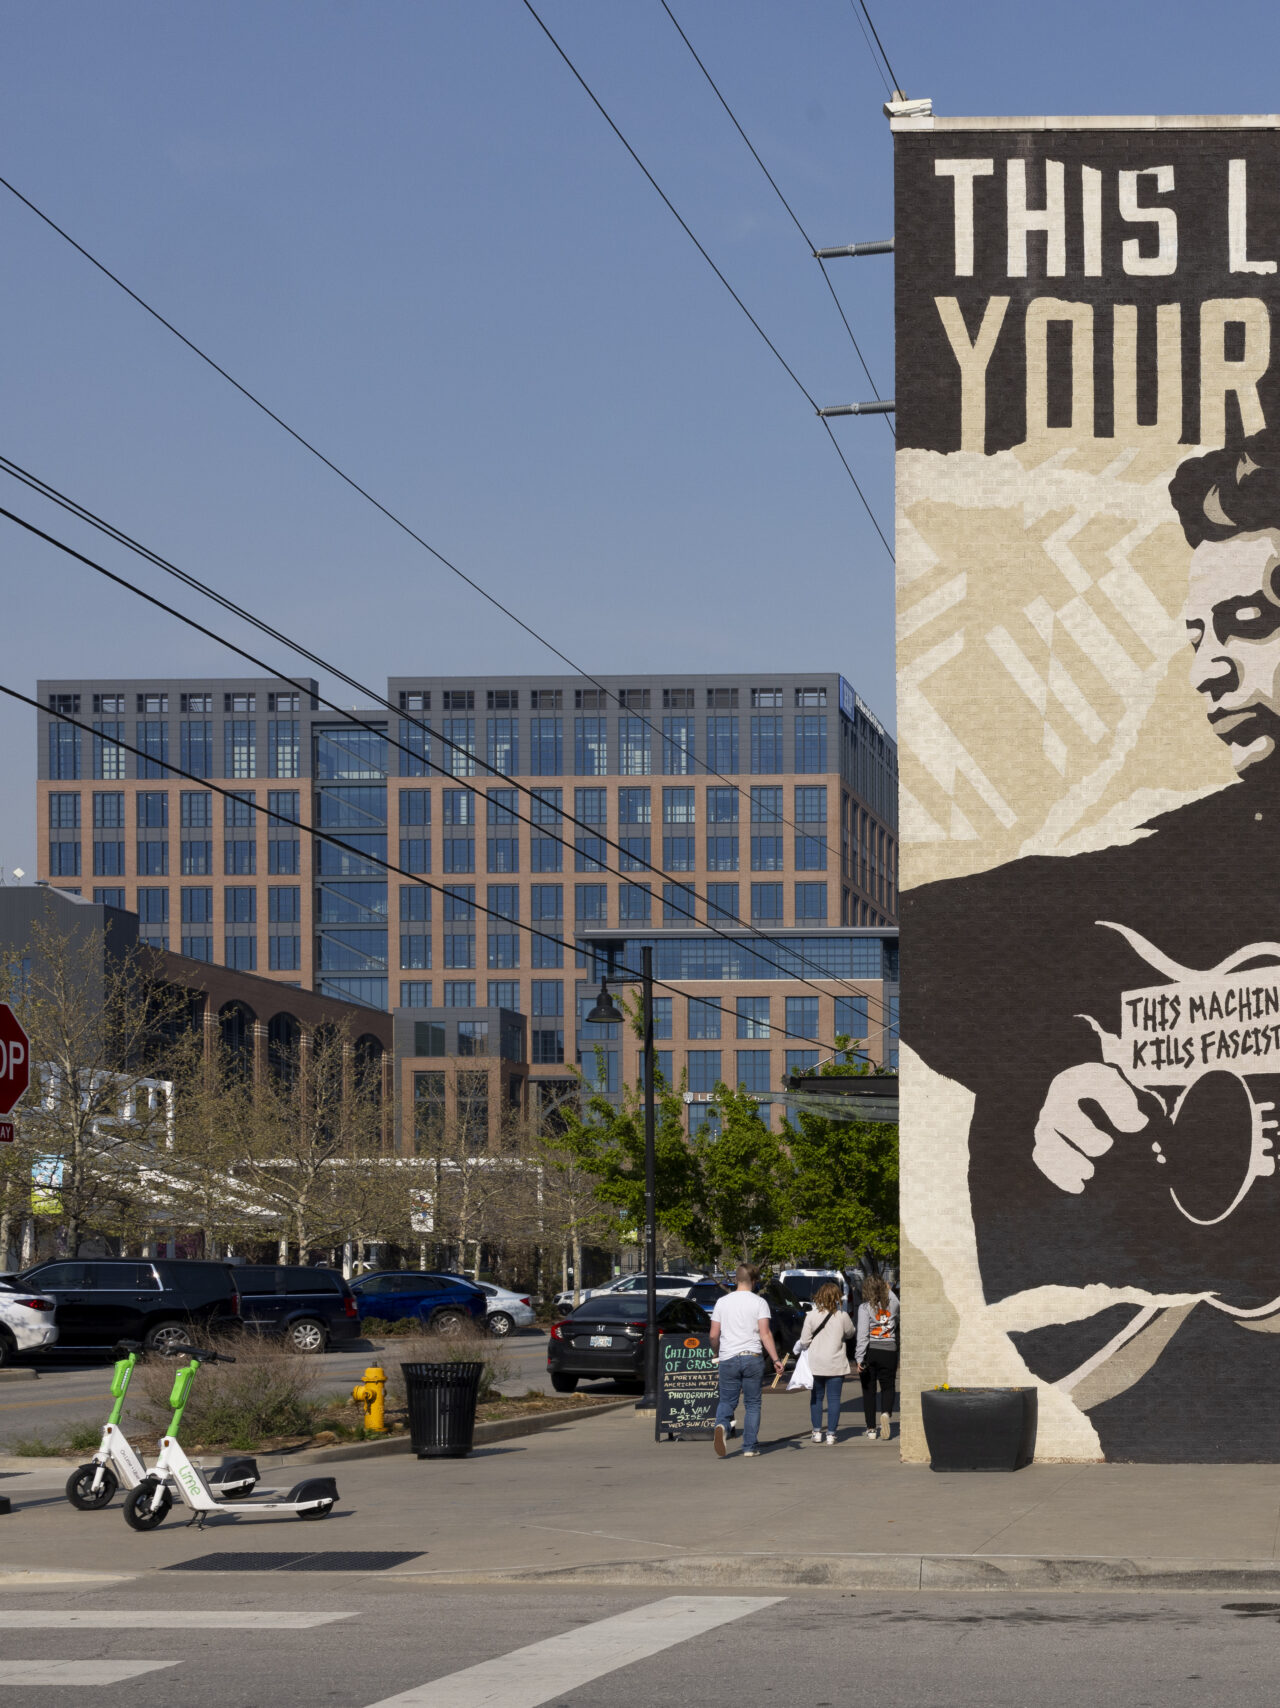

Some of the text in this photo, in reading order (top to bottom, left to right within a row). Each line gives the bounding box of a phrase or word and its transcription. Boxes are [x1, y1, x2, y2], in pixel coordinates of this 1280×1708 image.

[934, 157, 1178, 278] THIS
[934, 296, 1272, 455] YOUR
[1125, 993, 1181, 1033] THIS
[0, 1037, 25, 1080] OP
[1132, 1034, 1196, 1070] KILLS
[0, 1125, 11, 1140] AY
[664, 1345, 715, 1359] CHILDREN
[665, 1360, 682, 1372] OF
[668, 1390, 720, 1399] PHOTOGRAPHS
